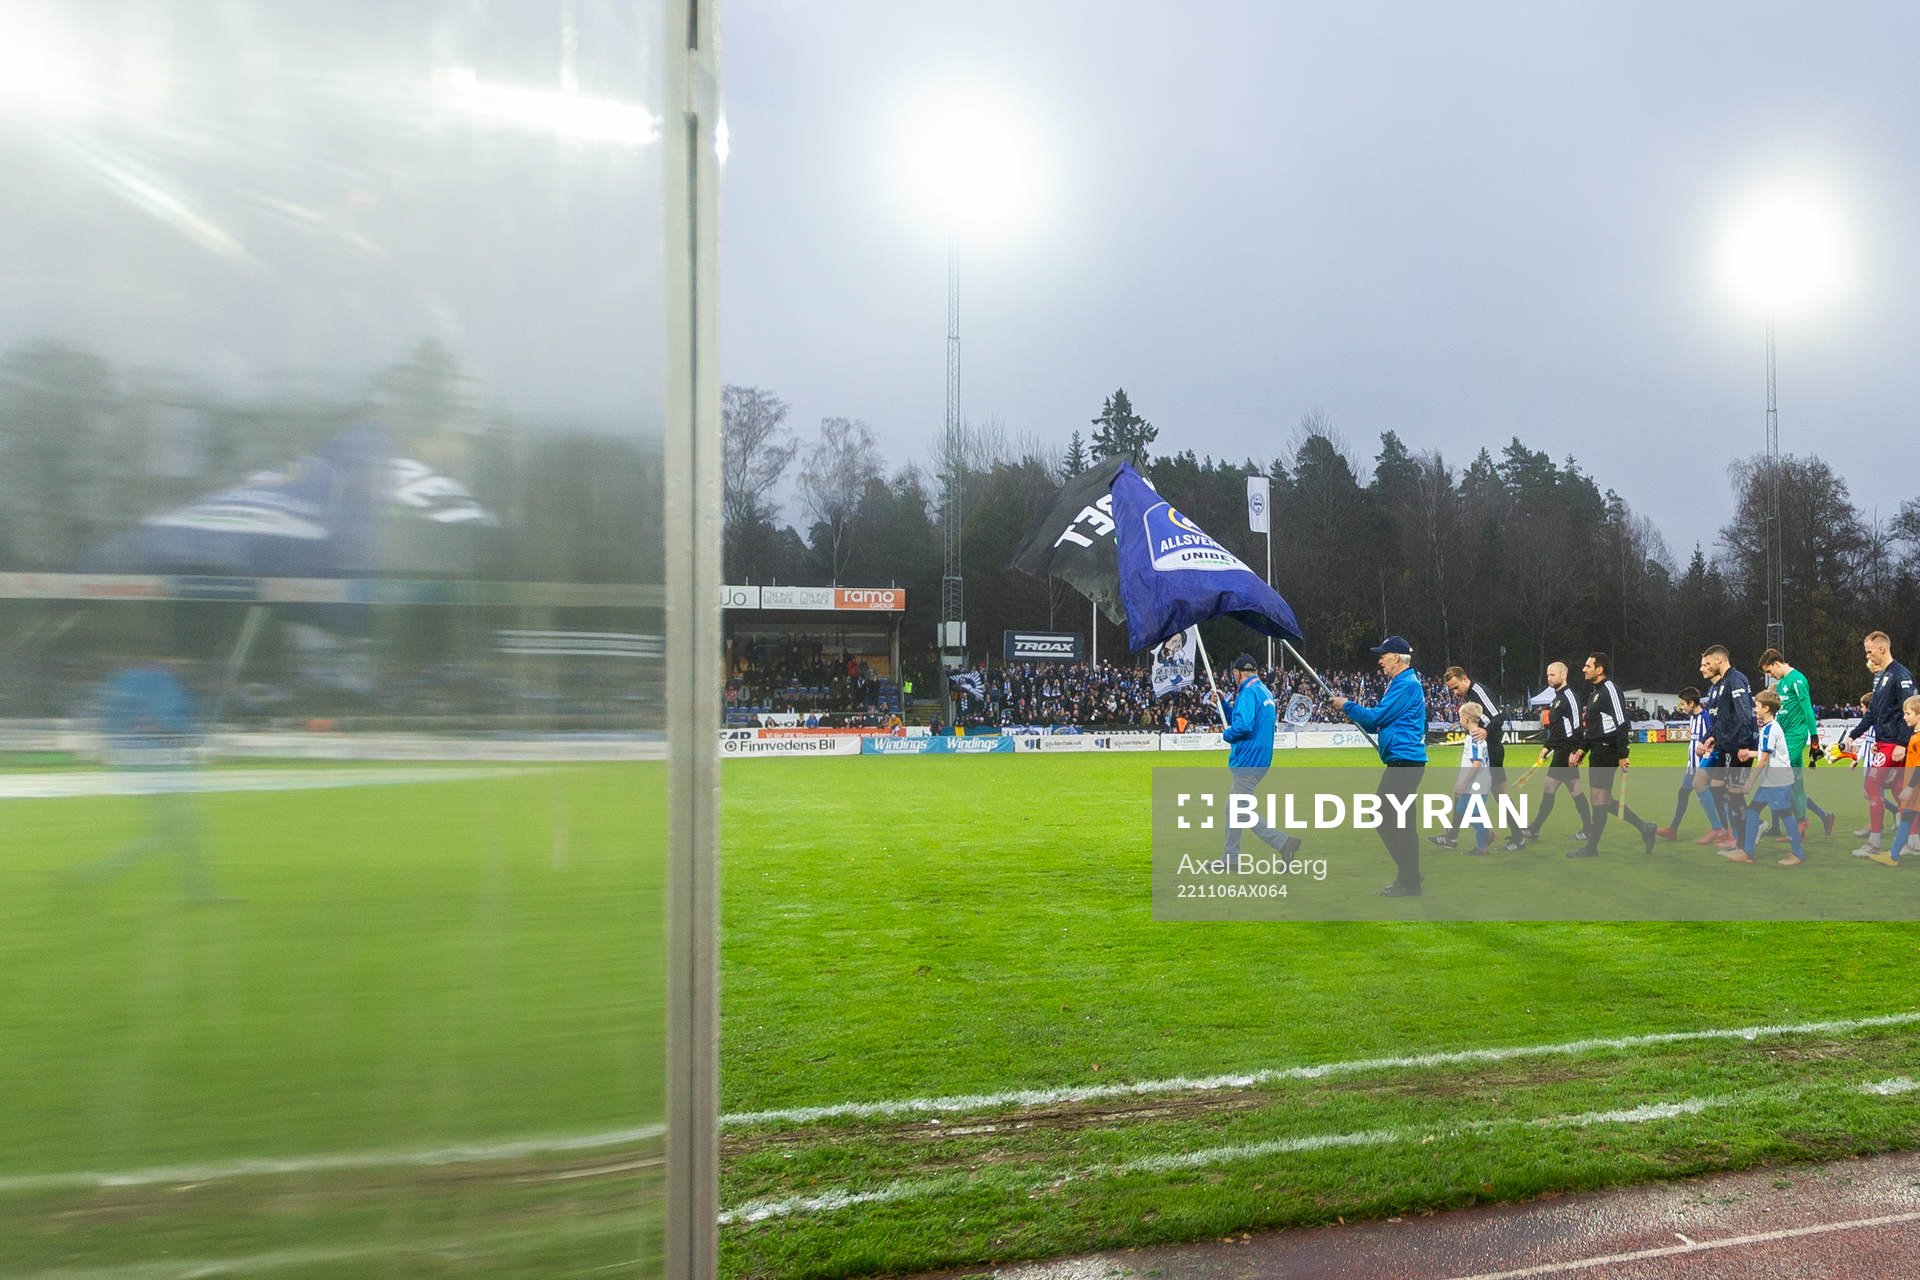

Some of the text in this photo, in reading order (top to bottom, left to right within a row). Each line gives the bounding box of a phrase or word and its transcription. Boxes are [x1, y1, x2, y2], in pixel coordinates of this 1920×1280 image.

[843, 590, 895, 603] ramo
[1014, 642, 1073, 651] TROAX
[947, 737, 999, 750] Windings
[1446, 732, 1466, 743] SM
[740, 739, 836, 752] Finnvedens Bil
[874, 738, 928, 750] Windings
